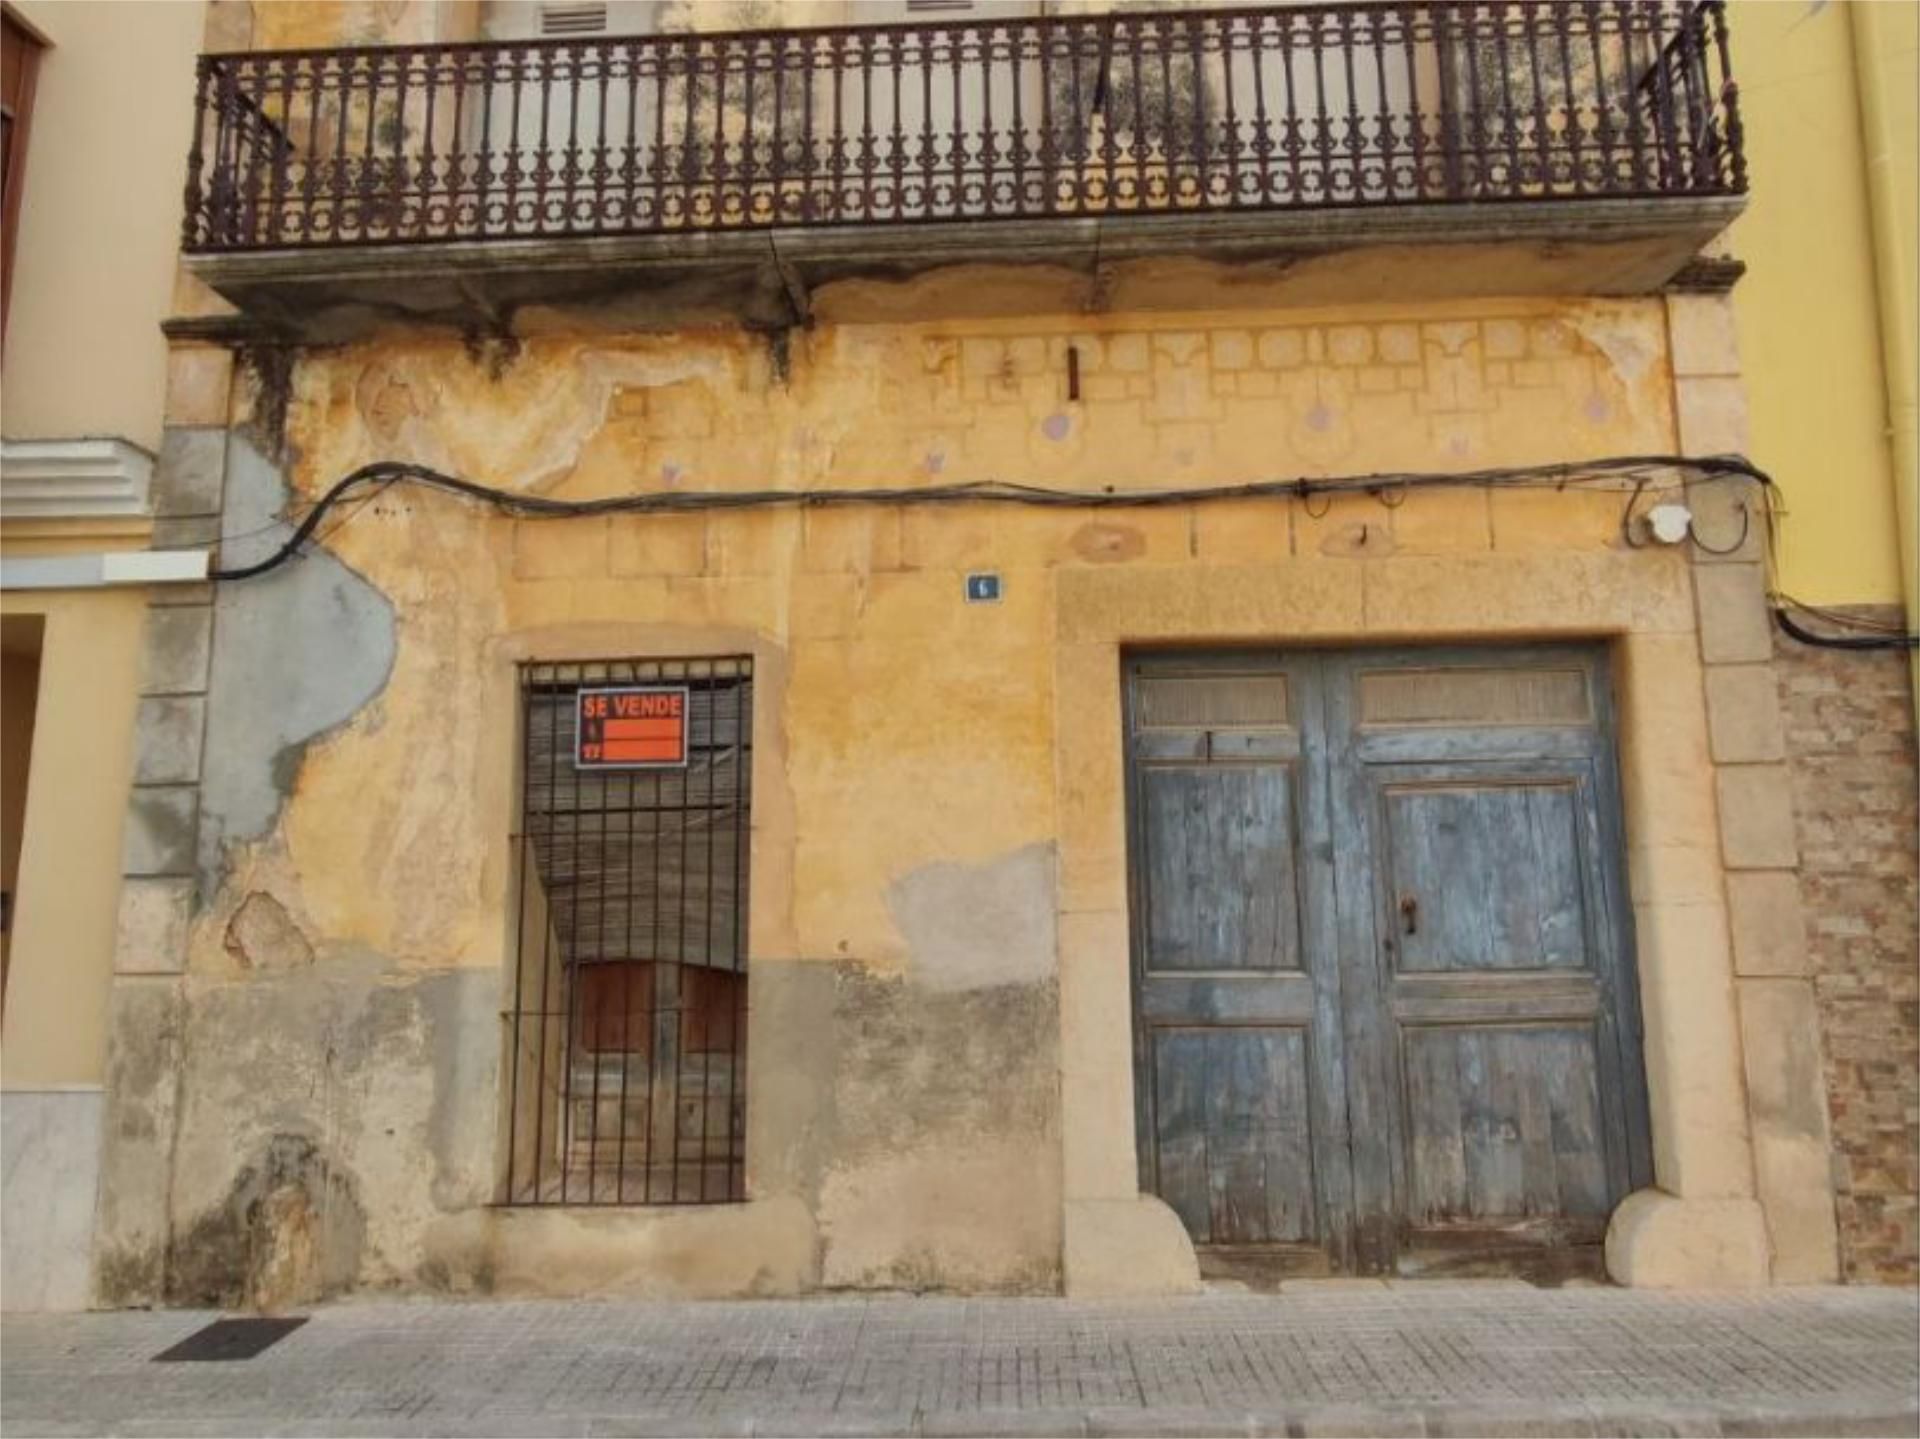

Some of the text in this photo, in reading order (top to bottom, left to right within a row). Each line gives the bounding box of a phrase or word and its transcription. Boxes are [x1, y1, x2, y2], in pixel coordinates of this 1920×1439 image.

[978, 579, 988, 597] 6
[584, 694, 682, 718] SE VENDE
